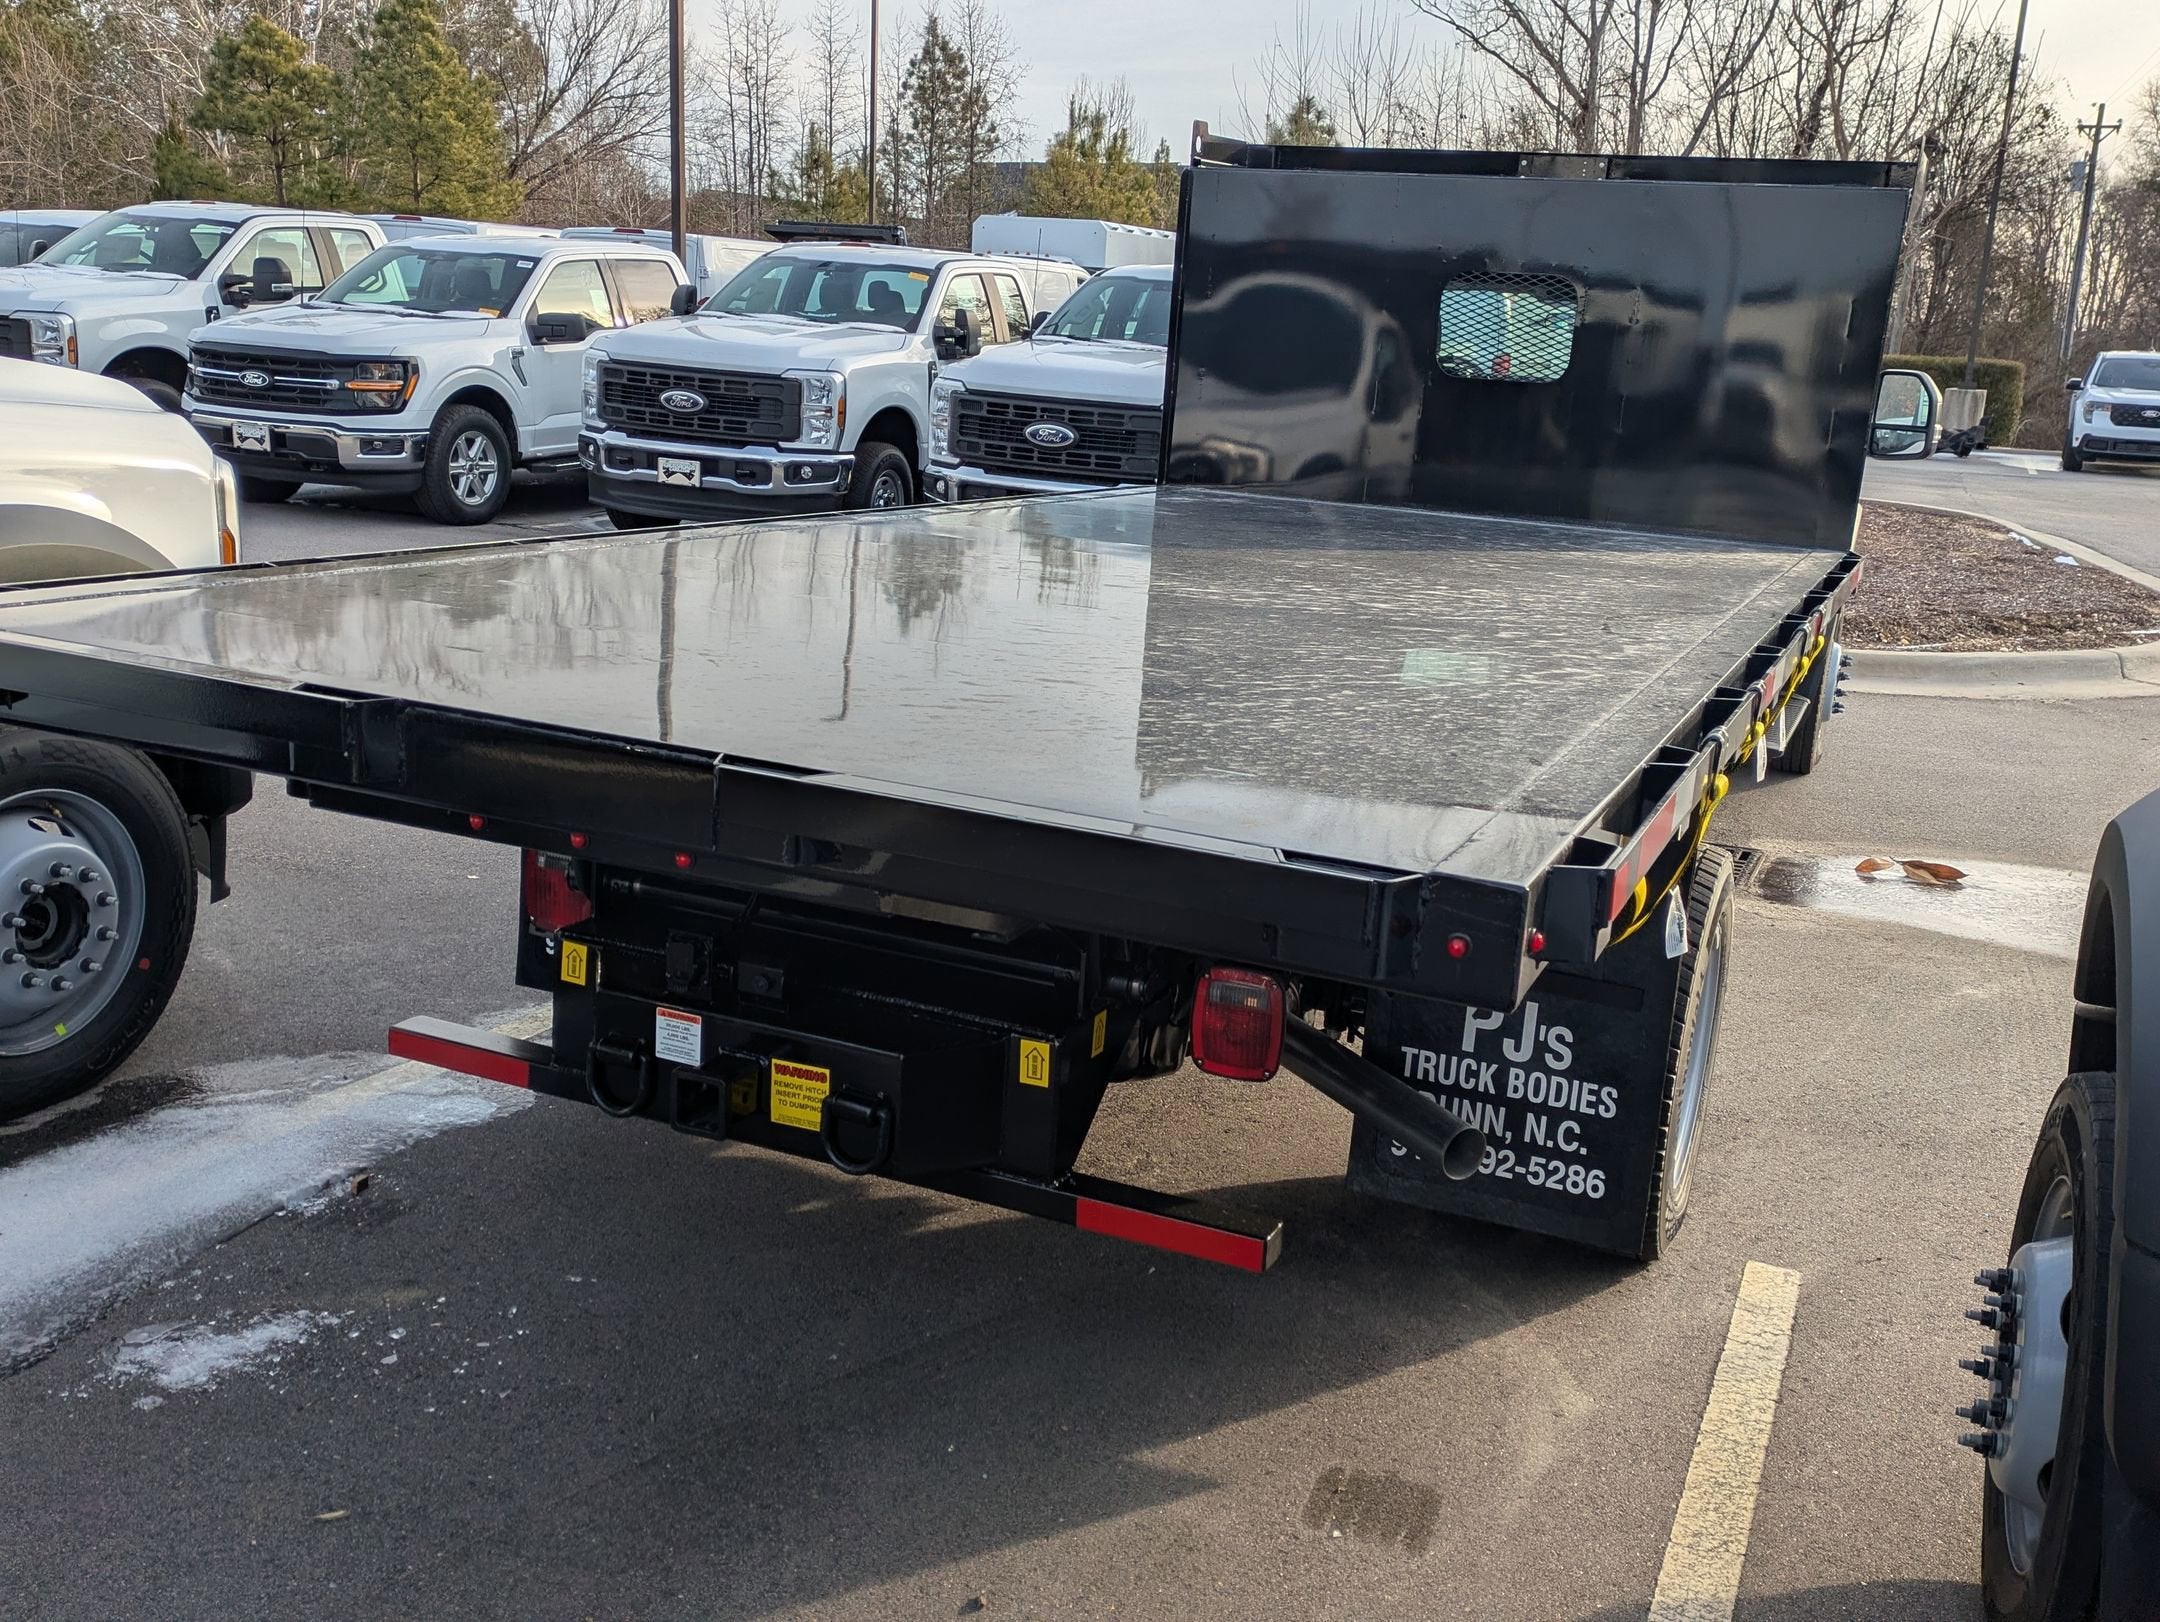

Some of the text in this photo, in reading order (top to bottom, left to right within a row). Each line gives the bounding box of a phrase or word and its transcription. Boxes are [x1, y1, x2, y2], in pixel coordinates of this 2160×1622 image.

[669, 394, 693, 408] Ford
[1036, 428, 1063, 442] Ford
[774, 1063, 827, 1084] WARNING
[774, 1080, 827, 1096] REMOVE HITCH
[1401, 1046, 1619, 1119] TRUCK BODIES
[775, 1089, 823, 1105] INSERT PRIO
[1417, 1090, 1588, 1155] NN, N.C.
